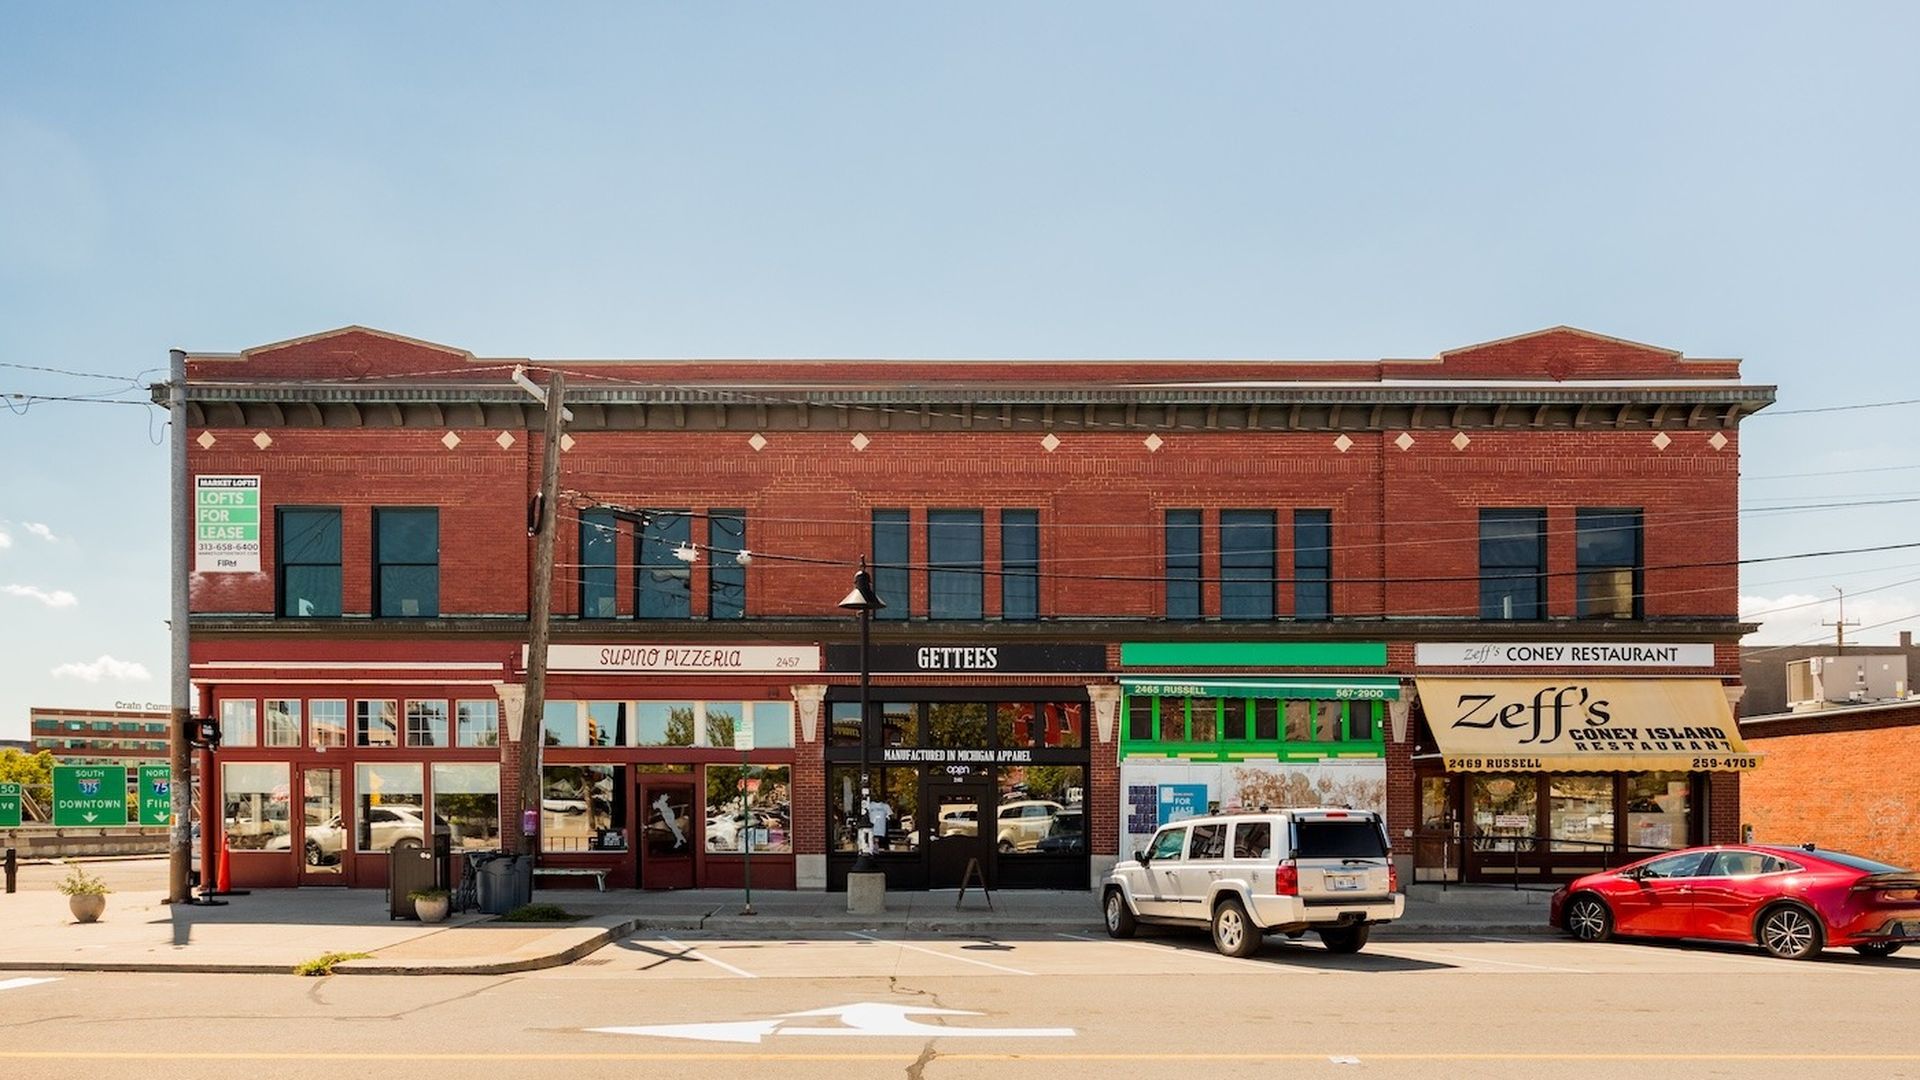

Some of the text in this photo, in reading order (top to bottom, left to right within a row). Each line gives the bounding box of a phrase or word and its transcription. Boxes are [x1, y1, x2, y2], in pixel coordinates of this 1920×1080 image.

[200, 492, 245, 504] LOFTS
[200, 509, 229, 522] FOR
[200, 526, 244, 539] LEASE
[199, 543, 259, 551] 313-658-6400
[664, 649, 742, 668] PIZZERIA
[917, 647, 998, 669] GETTEES
[1464, 644, 1679, 664] Zeff's CONEY RESTAURANT
[776, 656, 801, 668] 2457
[1135, 685, 1207, 695] 2465 RUSSELL
[114, 701, 142, 710] Crain
[1450, 686, 1611, 744] Zeff's
[1568, 726, 1727, 741] CONEY ISLAND
[1574, 741, 1731, 751] RESTAURANT
[883, 749, 1032, 762] MANUFACTURED IN MICHIGAN APPAREL
[1449, 758, 1542, 769] 2469 RUSSELL
[75, 769, 105, 778] SOUTH
[146, 769, 170, 777] NORT
[946, 765, 970, 776] open
[1, 785, 16, 794] 50
[83, 783, 98, 793] 375
[155, 783, 169, 793] 75
[0, 802, 15, 810] ve
[60, 800, 121, 809] DOWNTOWN
[146, 799, 170, 808] Flin
[1174, 797, 1192, 805] FOR
